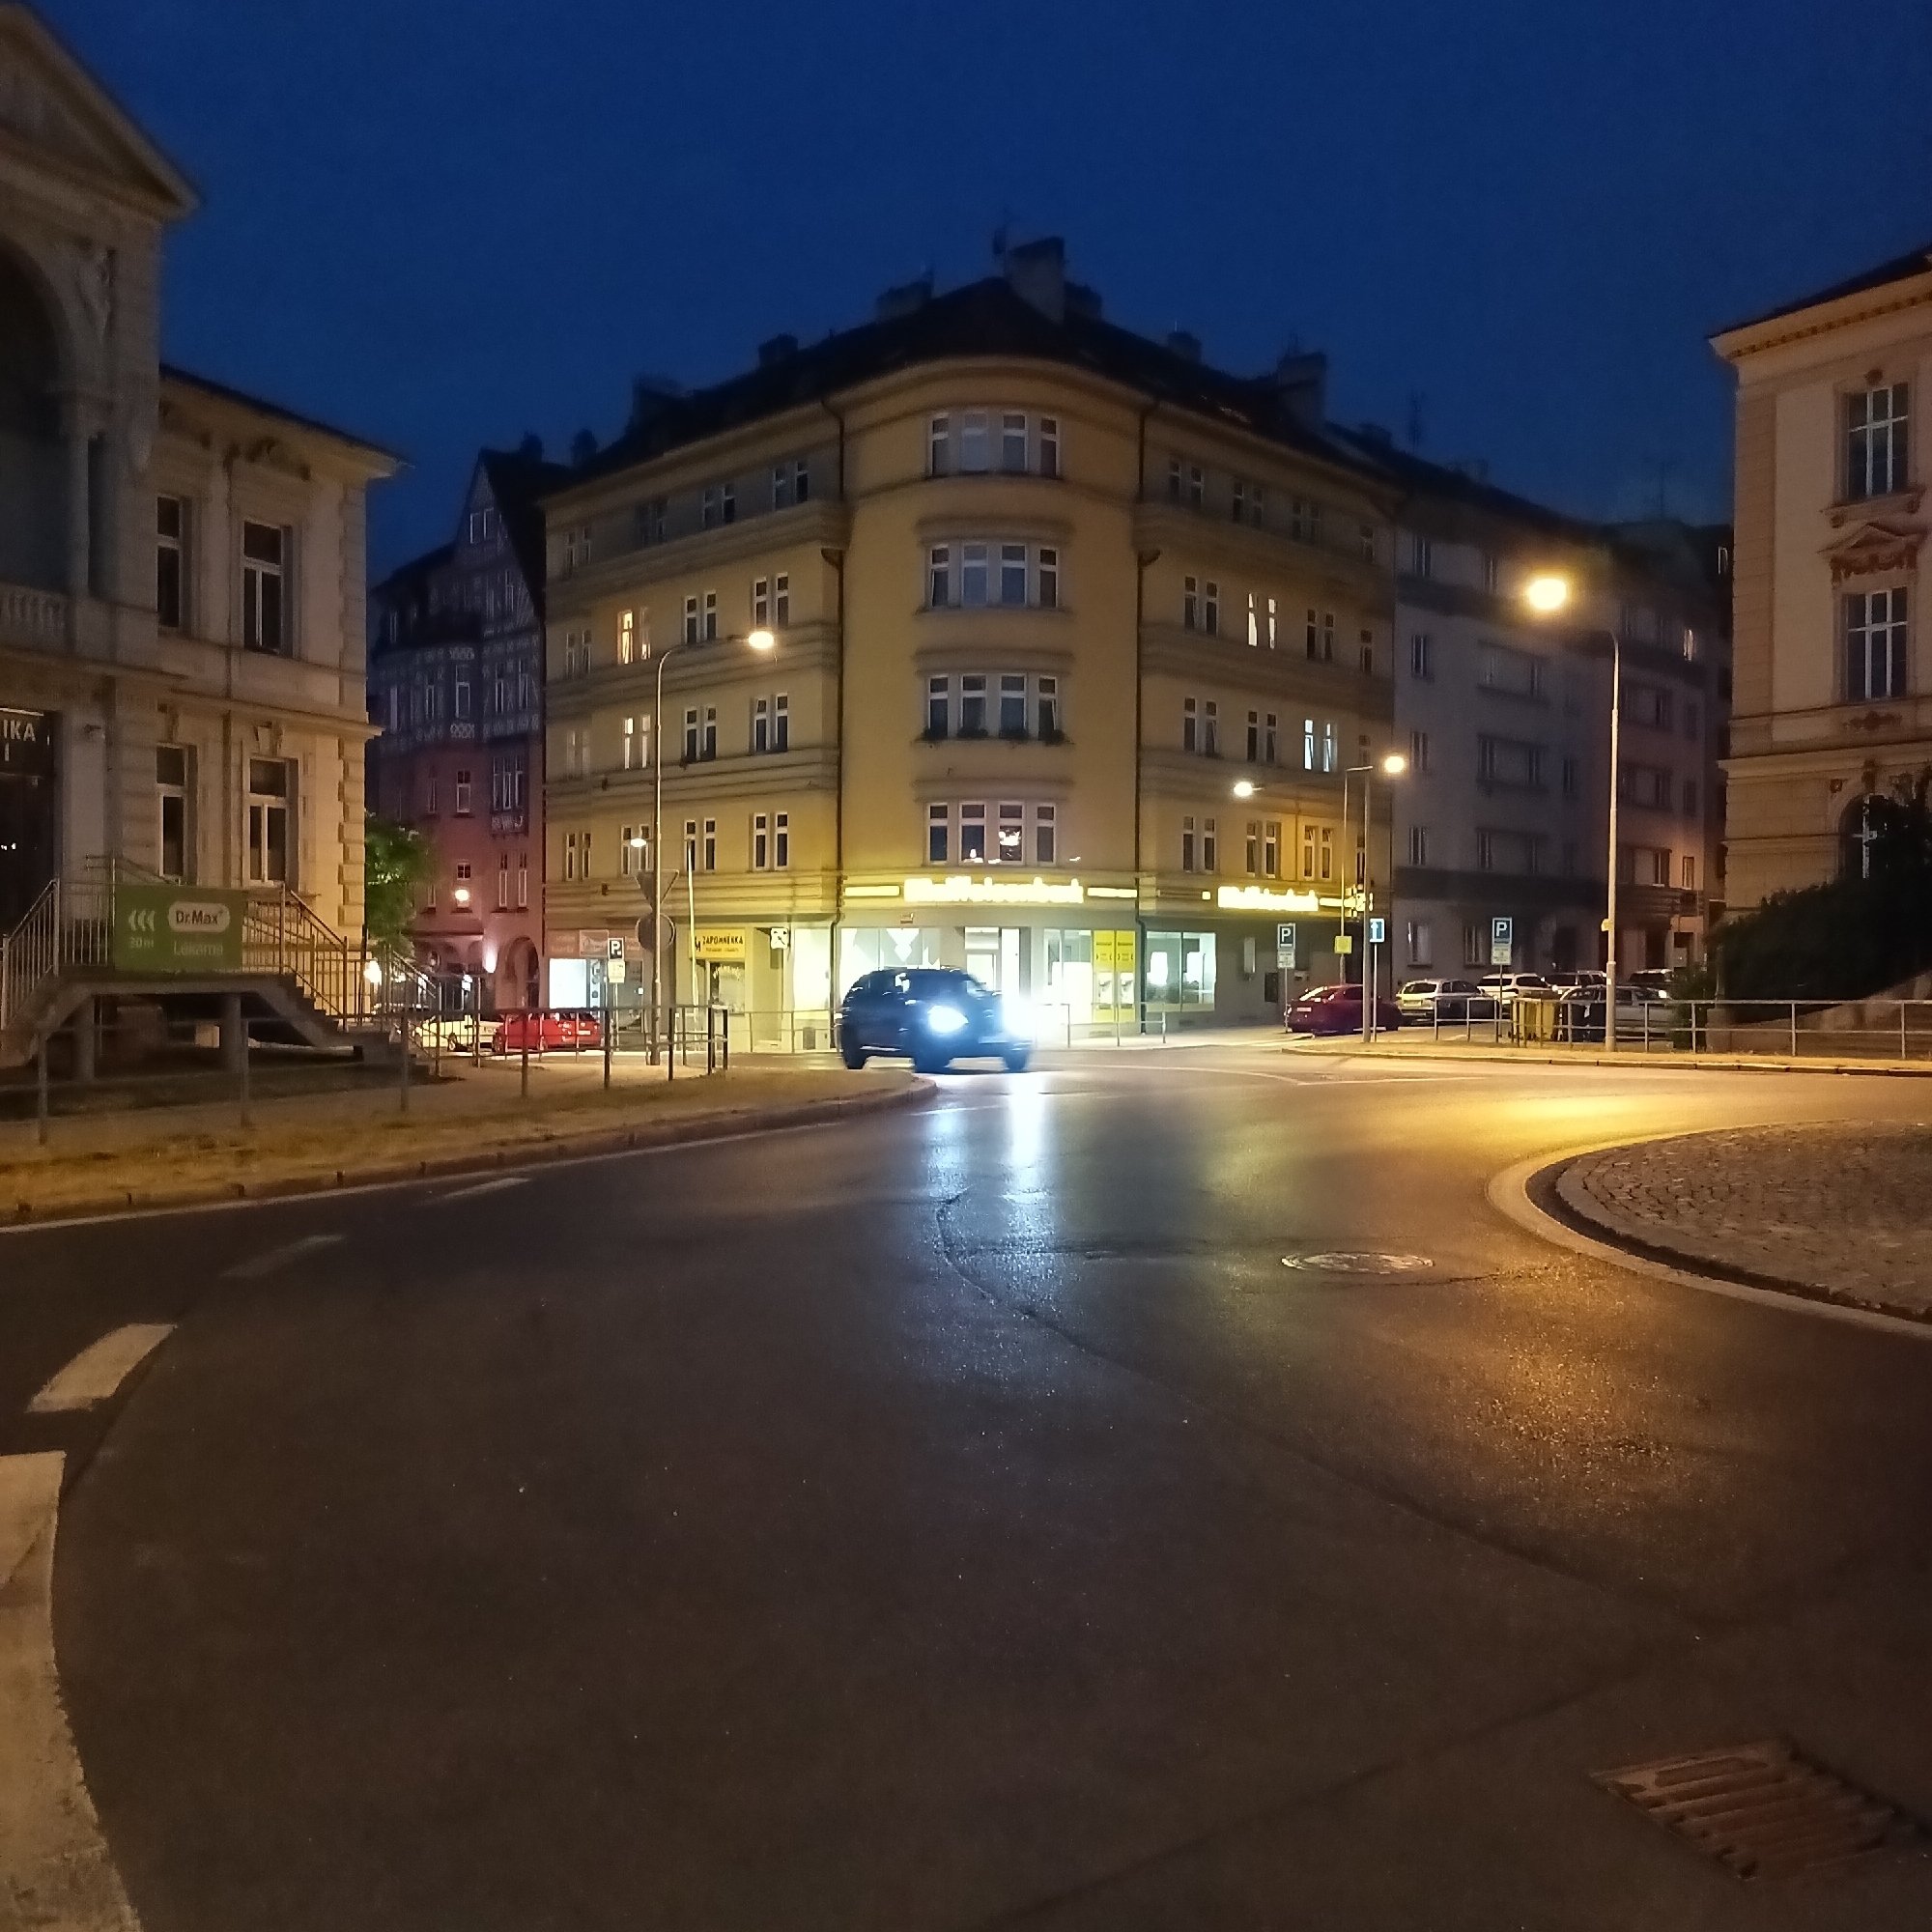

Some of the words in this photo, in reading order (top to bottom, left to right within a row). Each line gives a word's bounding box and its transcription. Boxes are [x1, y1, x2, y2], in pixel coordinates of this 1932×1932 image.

[1281, 927, 1292, 943] P
[1495, 921, 1508, 937] P
[611, 940, 621, 955] P
